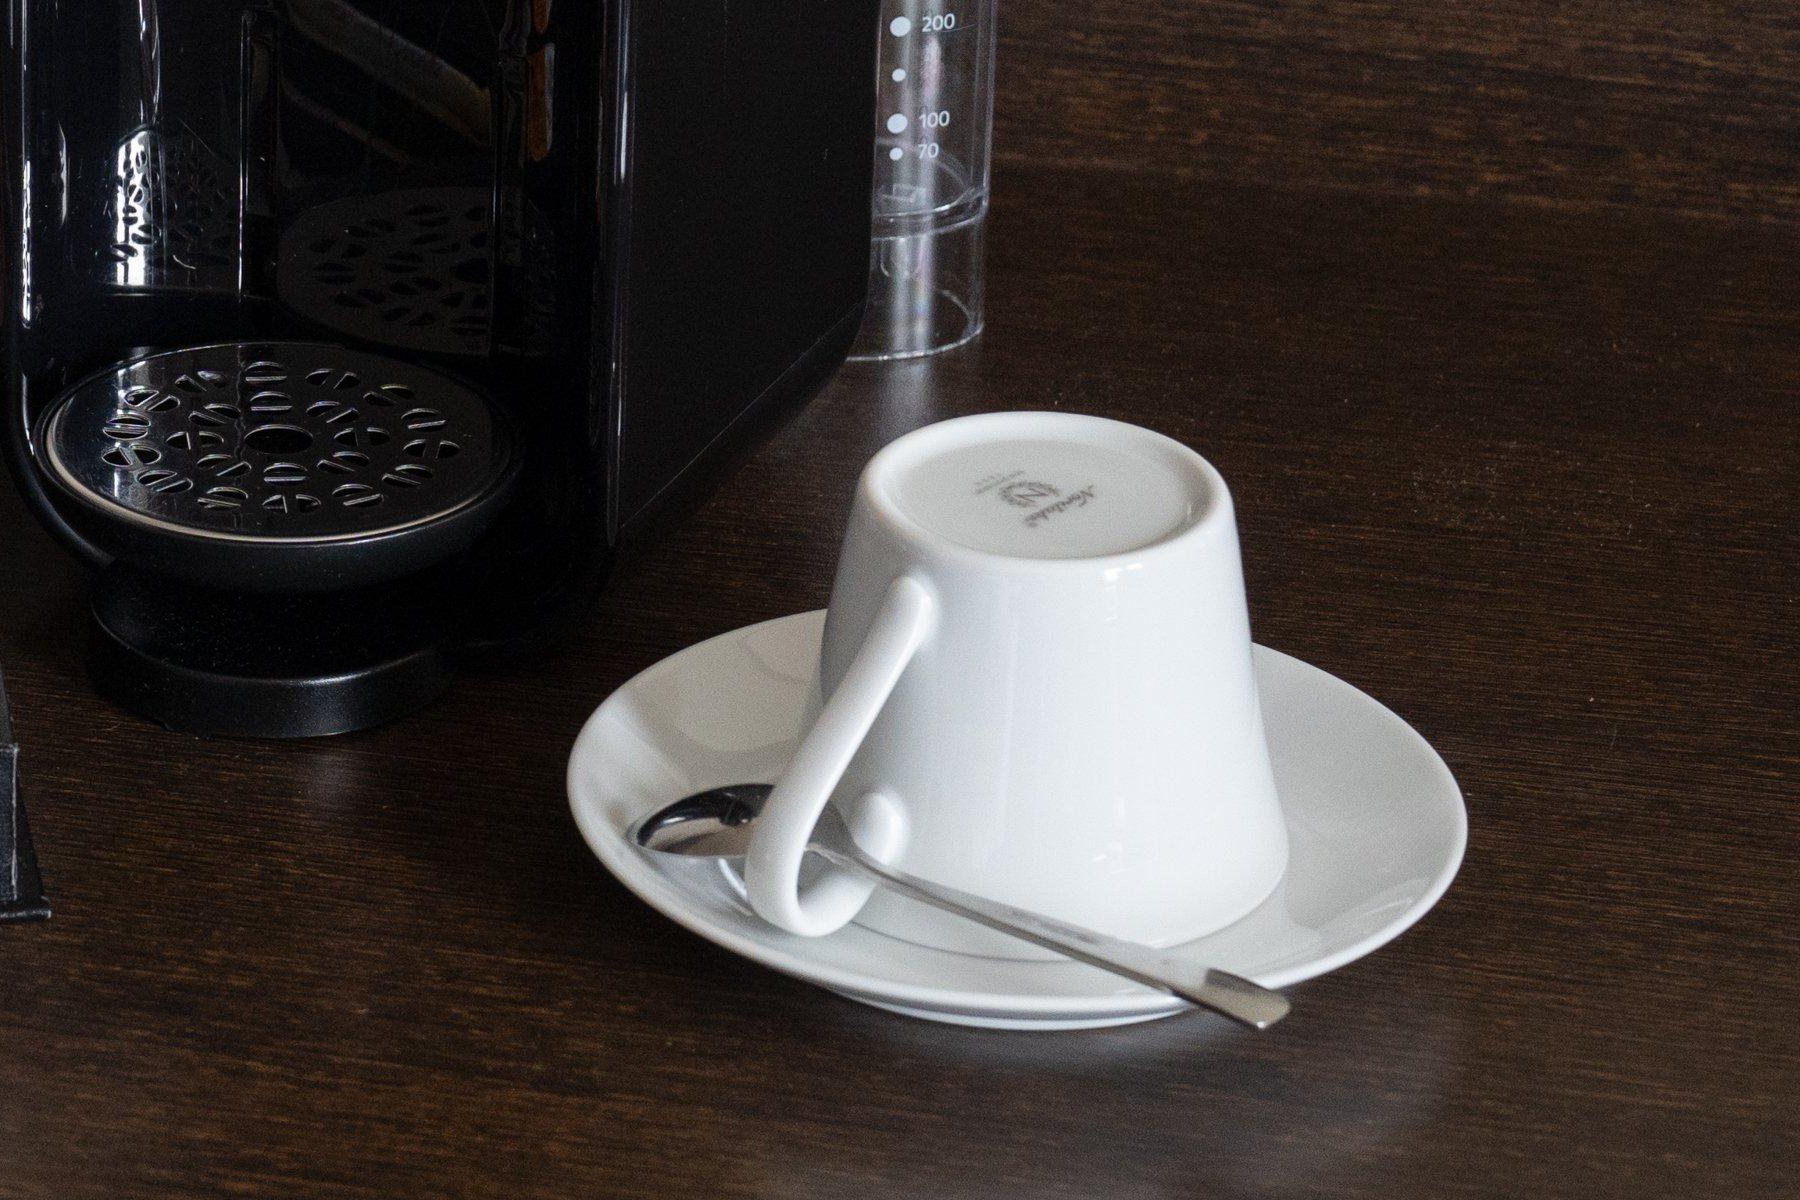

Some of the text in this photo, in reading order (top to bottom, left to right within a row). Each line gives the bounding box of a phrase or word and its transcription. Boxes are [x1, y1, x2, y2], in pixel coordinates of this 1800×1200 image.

[922, 13, 955, 32] 200
[918, 110, 950, 128] 100
[918, 143, 939, 159] 70
